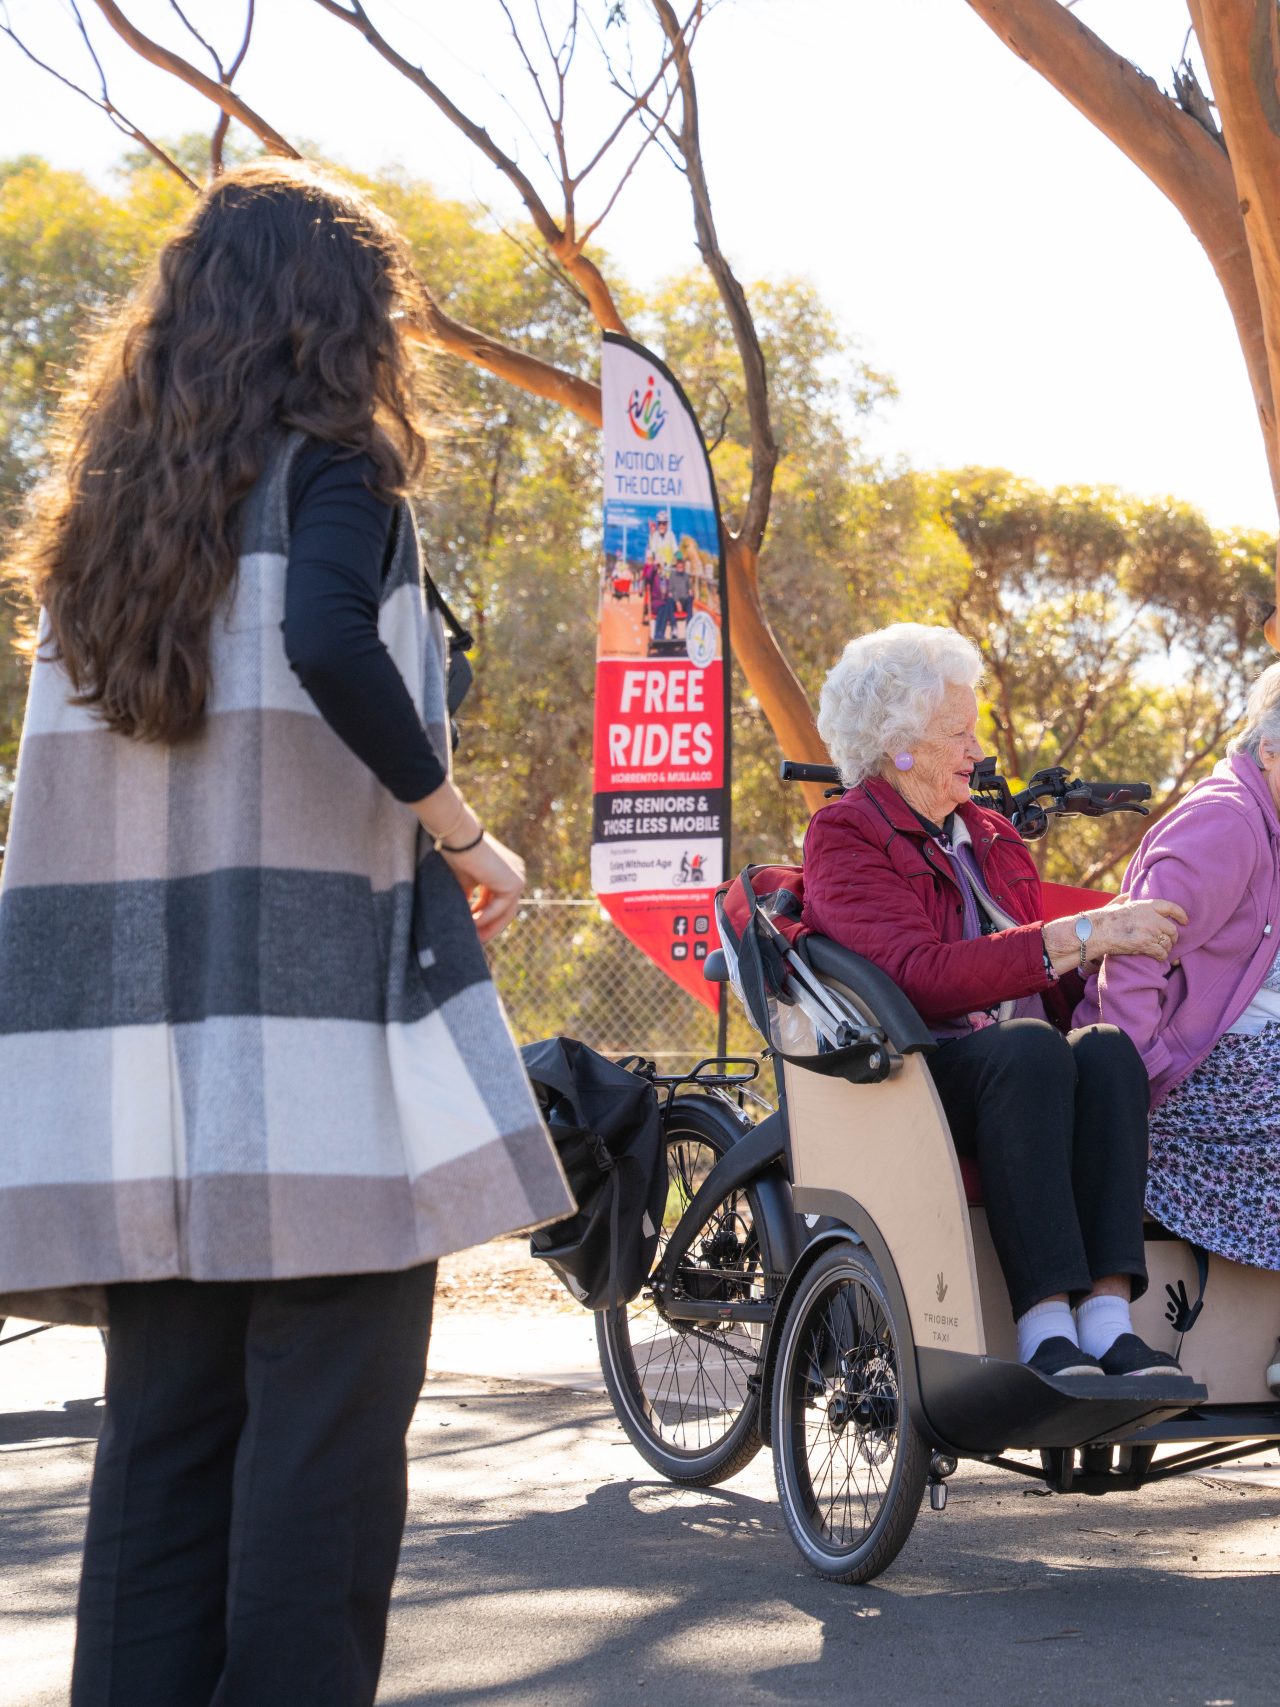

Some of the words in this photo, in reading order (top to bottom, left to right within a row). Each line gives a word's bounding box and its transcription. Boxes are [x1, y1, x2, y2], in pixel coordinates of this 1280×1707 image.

[615, 451, 663, 471] MOTION
[668, 453, 684, 472] BY
[614, 475, 638, 495] THE
[619, 670, 705, 714] FREE
[608, 722, 713, 768] RIDES
[611, 799, 633, 815] FOR
[634, 797, 696, 814] SENIORS
[697, 796, 709, 812] &
[603, 818, 634, 837] THOSE
[635, 817, 668, 835] LESS
[670, 815, 720, 833] MOBILE
[625, 860, 654, 868] Without
[656, 859, 673, 870] Age
[923, 1313, 959, 1327] TRIOBIKE
[932, 1331, 950, 1342] TAXI
